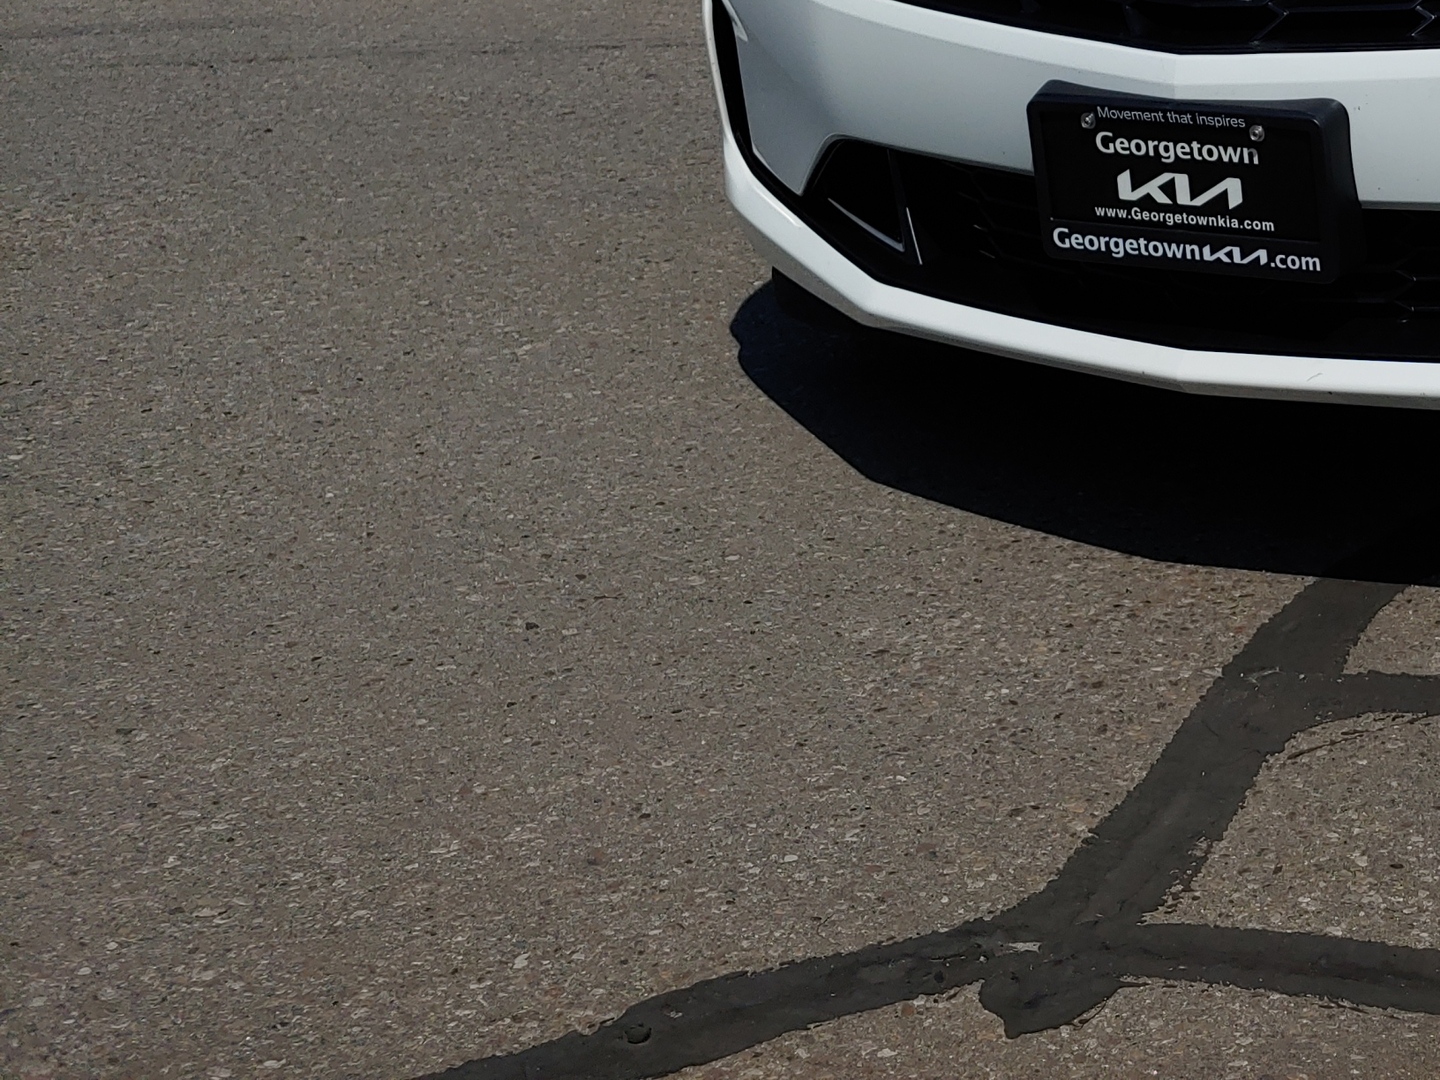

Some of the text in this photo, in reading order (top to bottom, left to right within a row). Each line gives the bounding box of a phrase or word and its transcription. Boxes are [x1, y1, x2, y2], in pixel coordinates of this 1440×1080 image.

[1096, 106, 1245, 128] Movement that inspires
[1095, 131, 1259, 165] Georgetown
[1116, 169, 1243, 210] KIA
[1094, 206, 1275, 232] www.Georgetownkia.com
